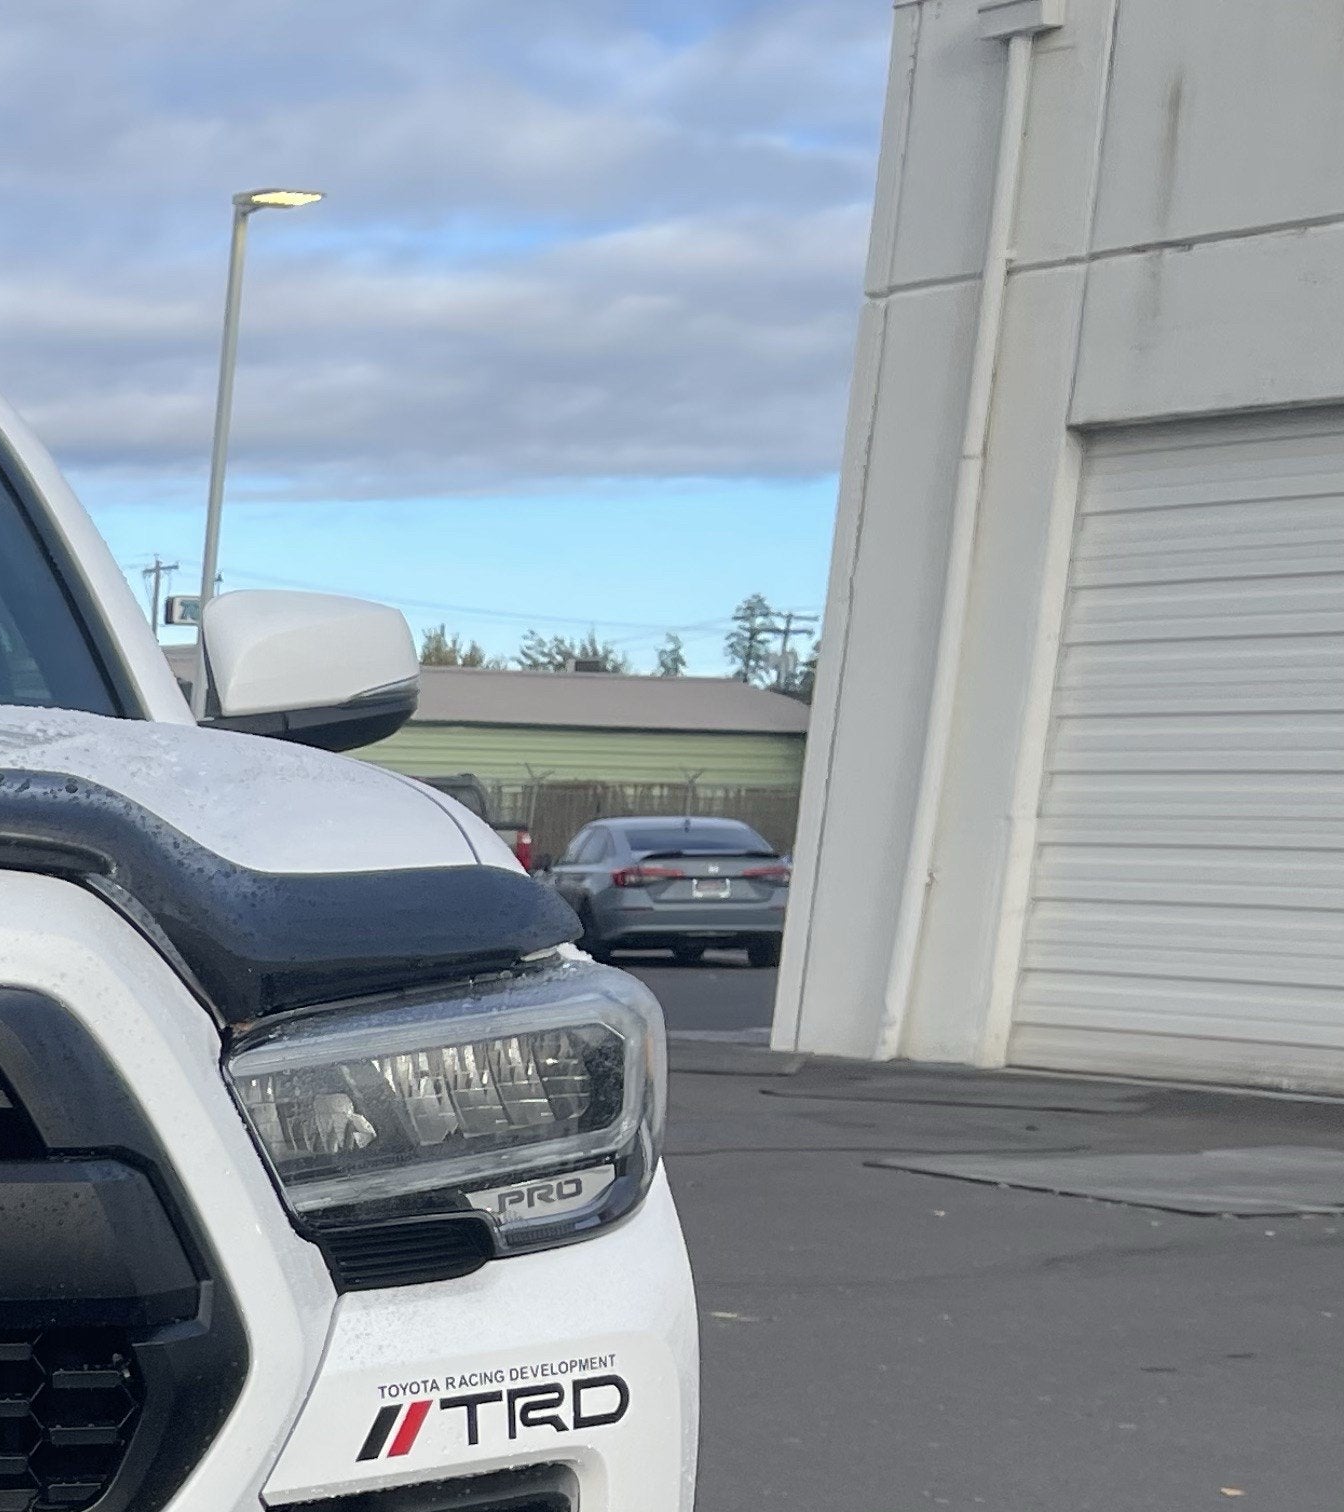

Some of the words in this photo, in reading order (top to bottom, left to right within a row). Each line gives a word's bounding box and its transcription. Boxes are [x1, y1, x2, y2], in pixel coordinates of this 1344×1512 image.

[497, 1177, 584, 1214] PRO
[378, 1379, 440, 1400] TOYOTA
[445, 1371, 505, 1391] RACING
[509, 1354, 616, 1382] DEVELOPMENT
[439, 1374, 630, 1446] TRD
